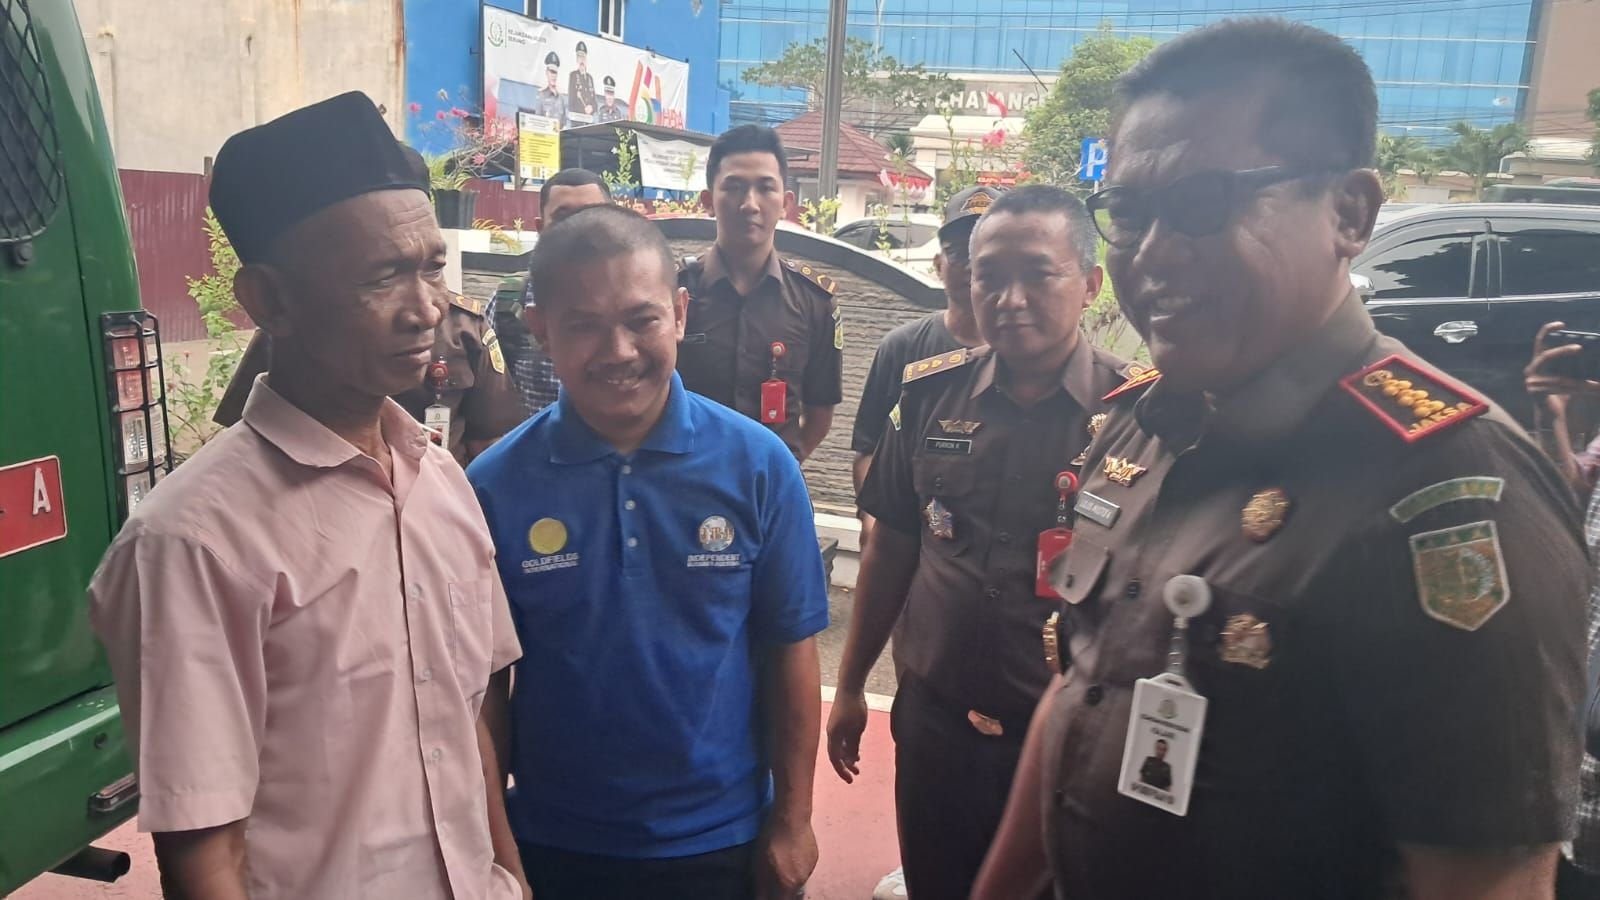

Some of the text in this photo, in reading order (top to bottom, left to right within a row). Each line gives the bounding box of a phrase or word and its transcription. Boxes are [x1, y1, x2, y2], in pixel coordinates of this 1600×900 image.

[1086, 142, 1107, 177] P
[32, 466, 51, 516] A
[521, 552, 579, 568] GOLDFIELDS
